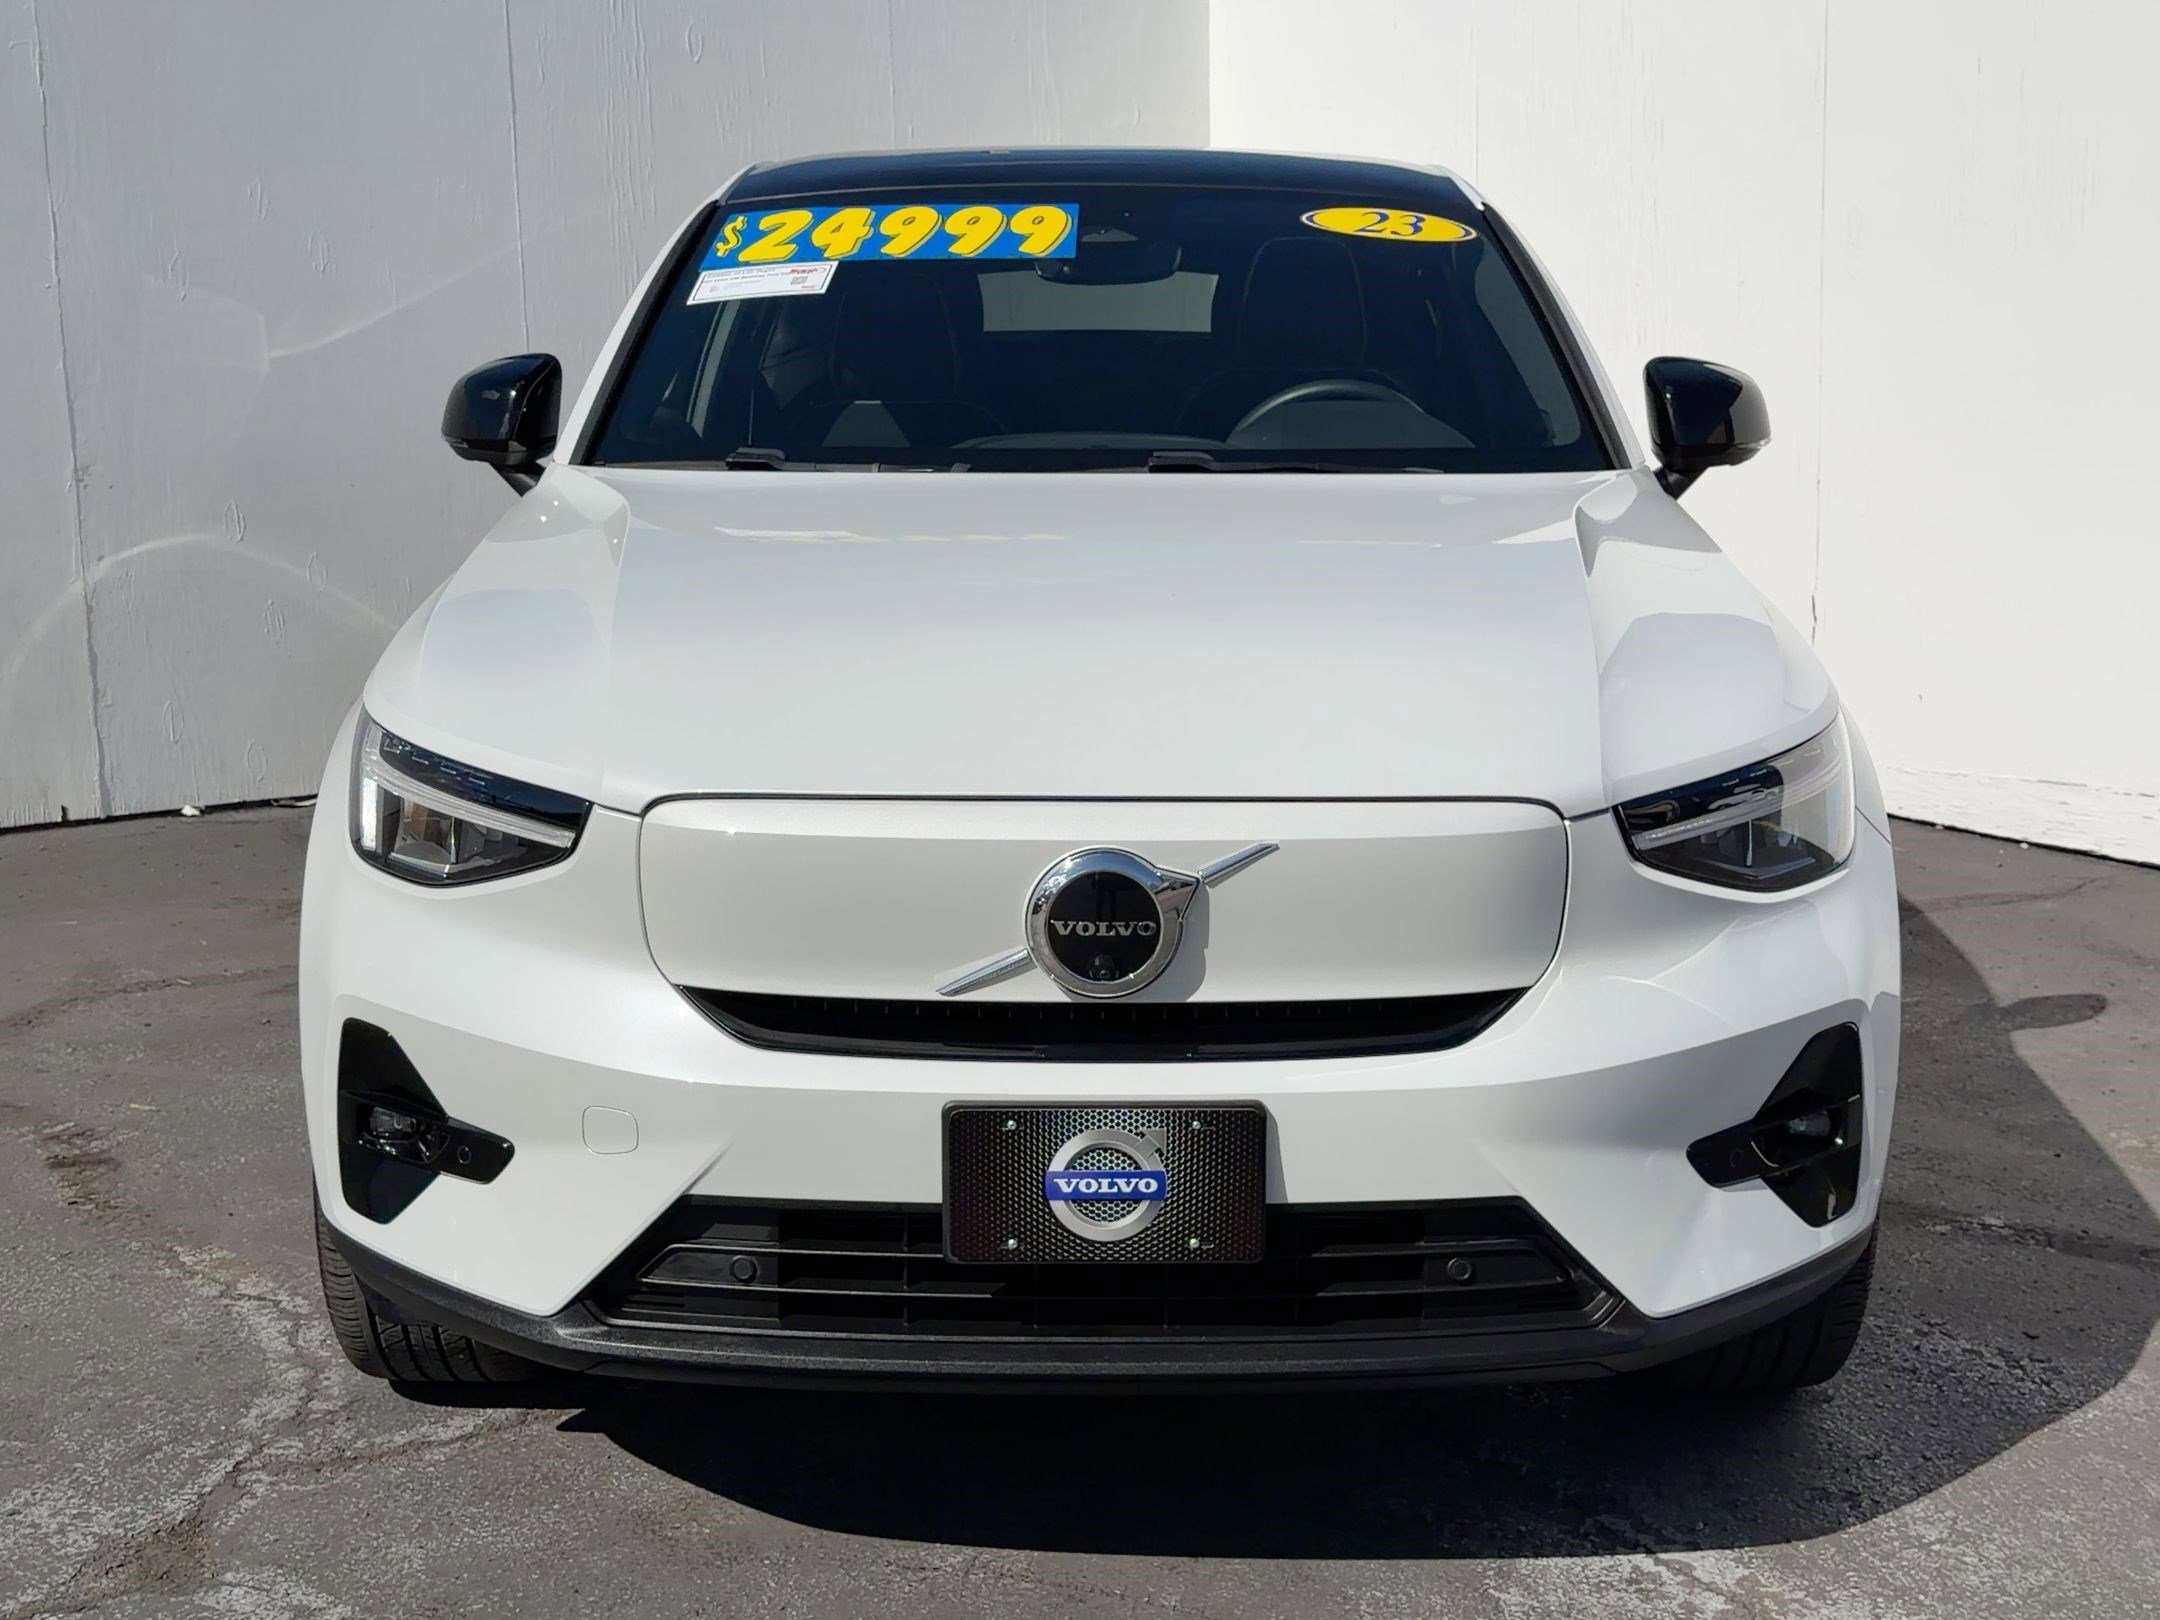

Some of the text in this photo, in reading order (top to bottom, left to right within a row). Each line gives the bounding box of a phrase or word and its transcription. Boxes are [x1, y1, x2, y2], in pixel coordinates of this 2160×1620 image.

[714, 205, 1072, 262] $24999
[1353, 211, 1426, 237] 23
[1051, 920, 1157, 937] VOLVO
[1053, 1178, 1159, 1194] VOLVO
